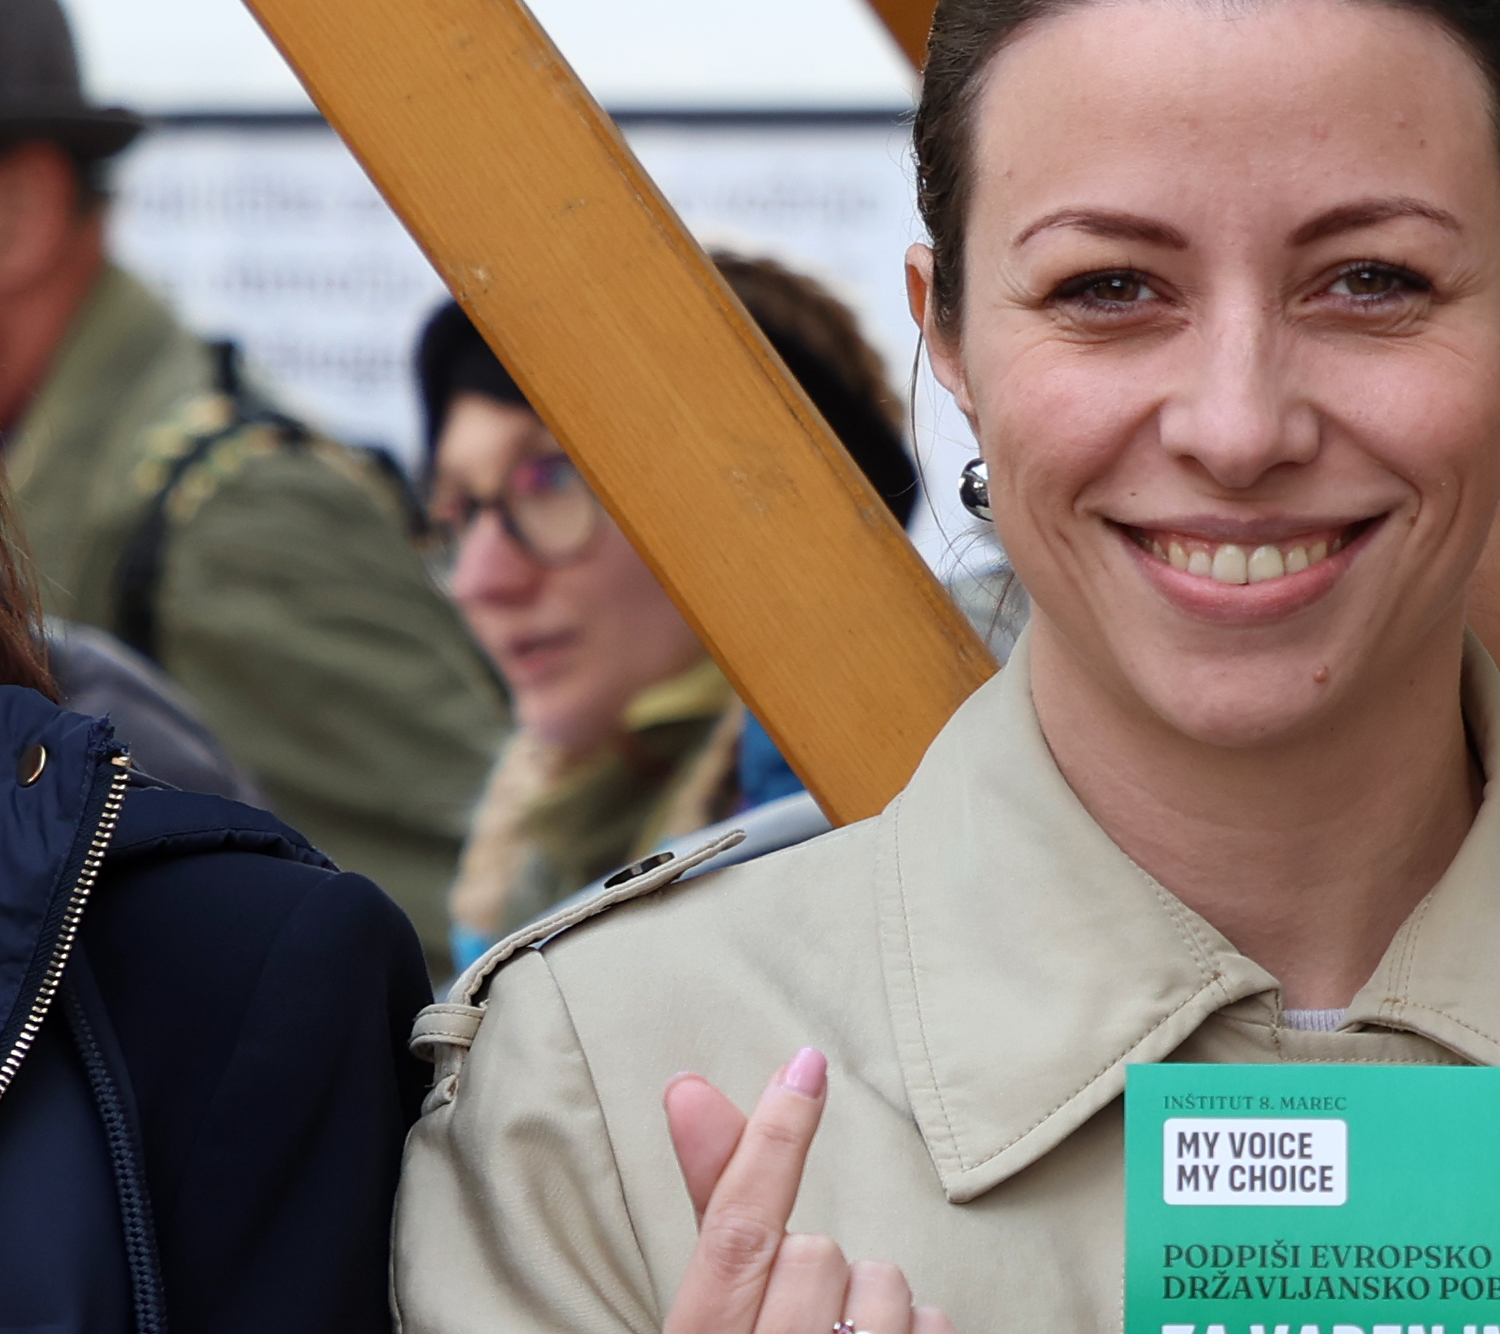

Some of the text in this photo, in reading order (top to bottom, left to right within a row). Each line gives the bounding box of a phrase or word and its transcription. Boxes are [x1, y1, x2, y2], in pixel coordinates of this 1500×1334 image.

[1163, 1093, 1347, 1111] INŠTITUT 8. MAREC
[1177, 1132, 1312, 1159] MY VOICE
[1177, 1165, 1333, 1193] MY CHOICE
[1162, 1239, 1491, 1269] PODPIŠI EVROPSKO
[1162, 1271, 1430, 1301] DRŽAVLJANSKO
